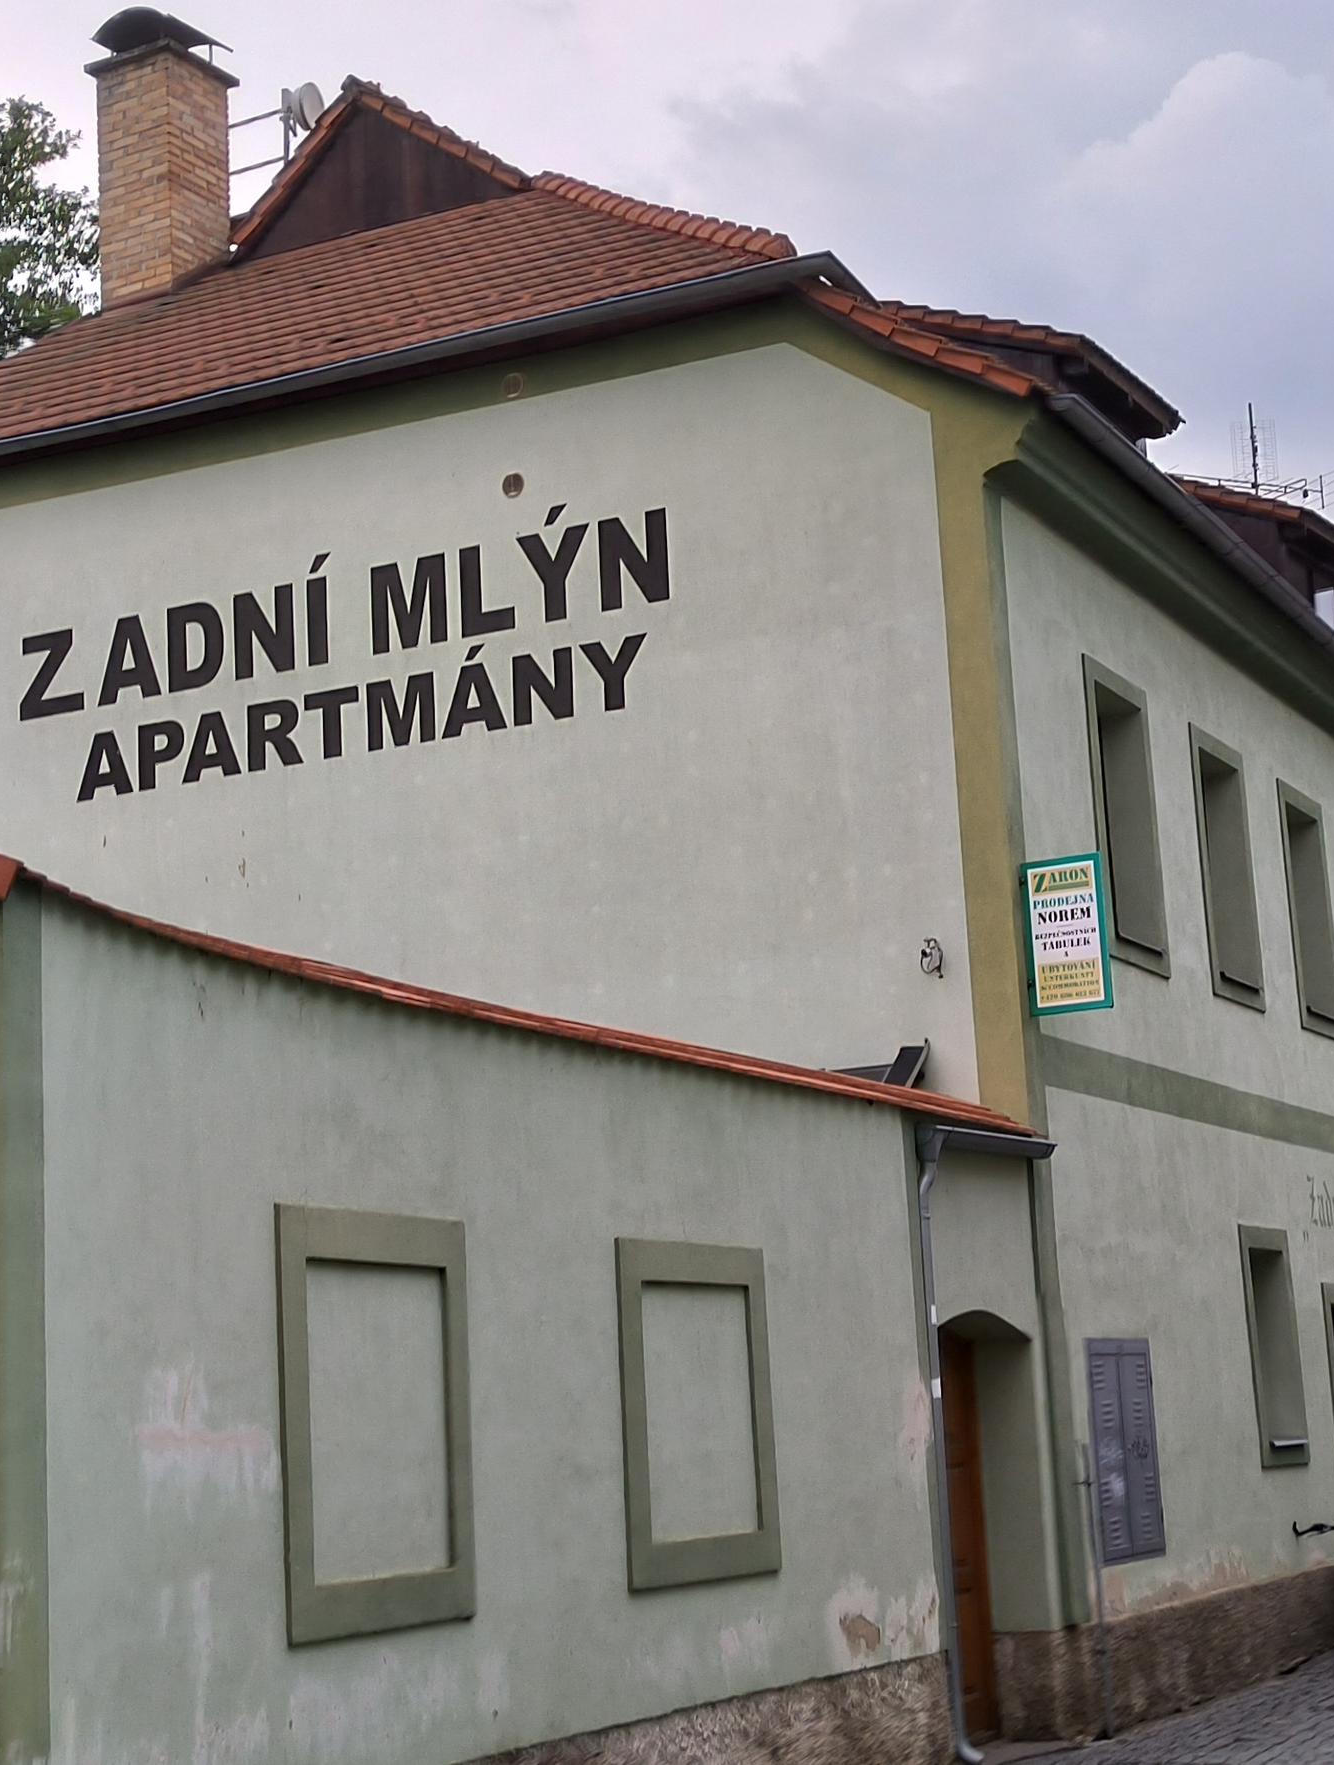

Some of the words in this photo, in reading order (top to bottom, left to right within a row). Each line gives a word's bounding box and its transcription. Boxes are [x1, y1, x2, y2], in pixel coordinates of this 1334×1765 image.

[19, 552, 330, 721] ZADNÍ
[369, 503, 670, 655] MLÝN
[76, 632, 647, 803] APARTMÁNY
[1033, 867, 1088, 893] ZARON
[1033, 893, 1094, 909] PRODEJNA
[1038, 906, 1091, 925] NOREM
[1041, 936, 1090, 951] TABULEK
